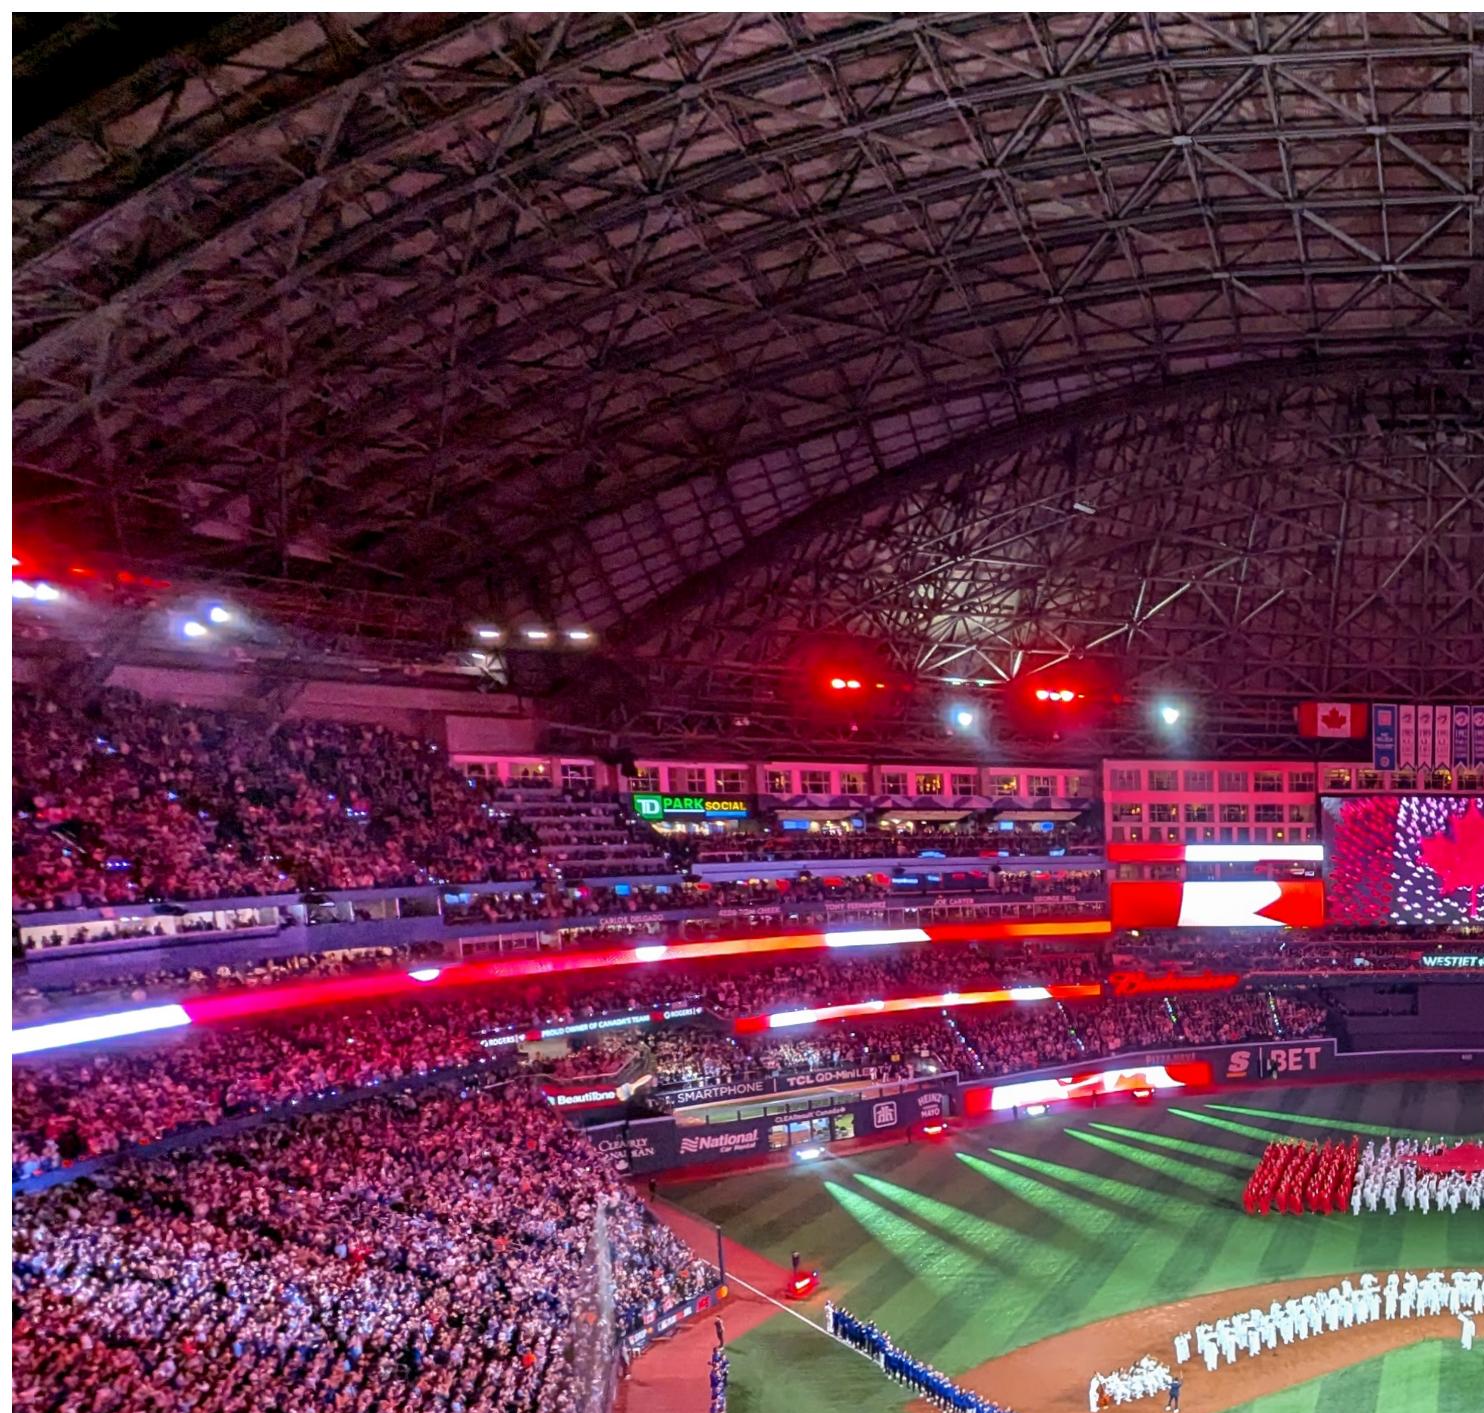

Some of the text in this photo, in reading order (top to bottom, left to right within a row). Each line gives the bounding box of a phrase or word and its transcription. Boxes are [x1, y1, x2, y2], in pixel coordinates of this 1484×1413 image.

[637, 797, 747, 814] TD PARK SOCIAL
[670, 1008, 693, 1018] ROGERS
[541, 1026, 565, 1039] PROUD
[565, 1023, 589, 1036] OWNER
[589, 1021, 598, 1031] OF
[630, 1014, 650, 1025] TEAM
[1269, 1046, 1322, 1072] BET
[787, 1074, 814, 1087] TCL
[557, 1089, 616, 1106] BeautiTone
[676, 1081, 764, 1105] SMARTPHONE
[917, 1093, 943, 1107] HEINZ
[920, 1107, 941, 1118] MAYO
[699, 1128, 759, 1150] National
